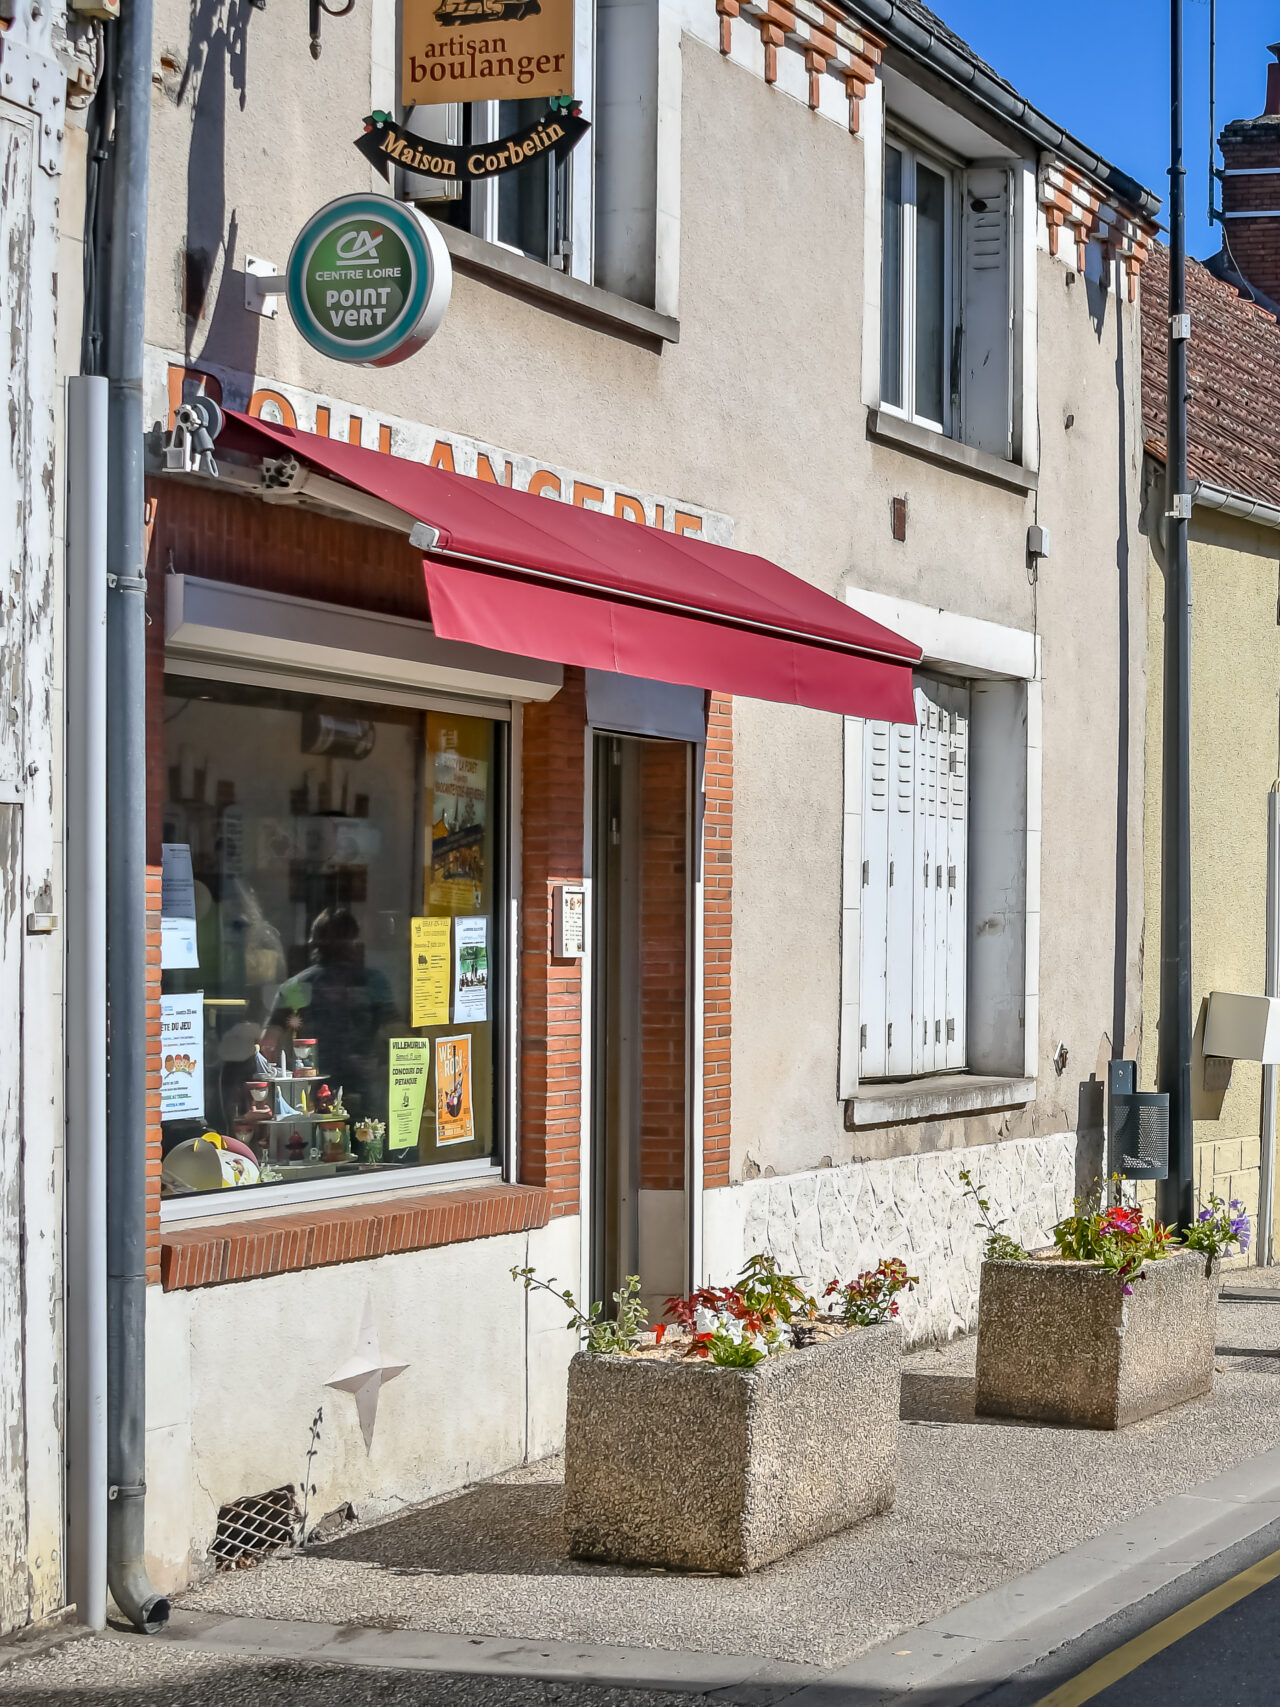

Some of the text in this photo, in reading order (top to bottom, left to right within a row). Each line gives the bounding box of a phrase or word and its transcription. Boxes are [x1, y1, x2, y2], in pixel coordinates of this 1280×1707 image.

[425, 34, 507, 58] artisan
[409, 53, 565, 84] boulanger
[379, 123, 565, 176] Maison Corbelin
[315, 268, 401, 281] CENTRE LOIRE
[171, 1022, 179, 1031] DU
[180, 1021, 192, 1031] JEU
[438, 1042, 453, 1062] WE
[415, 1067, 424, 1075] DE
